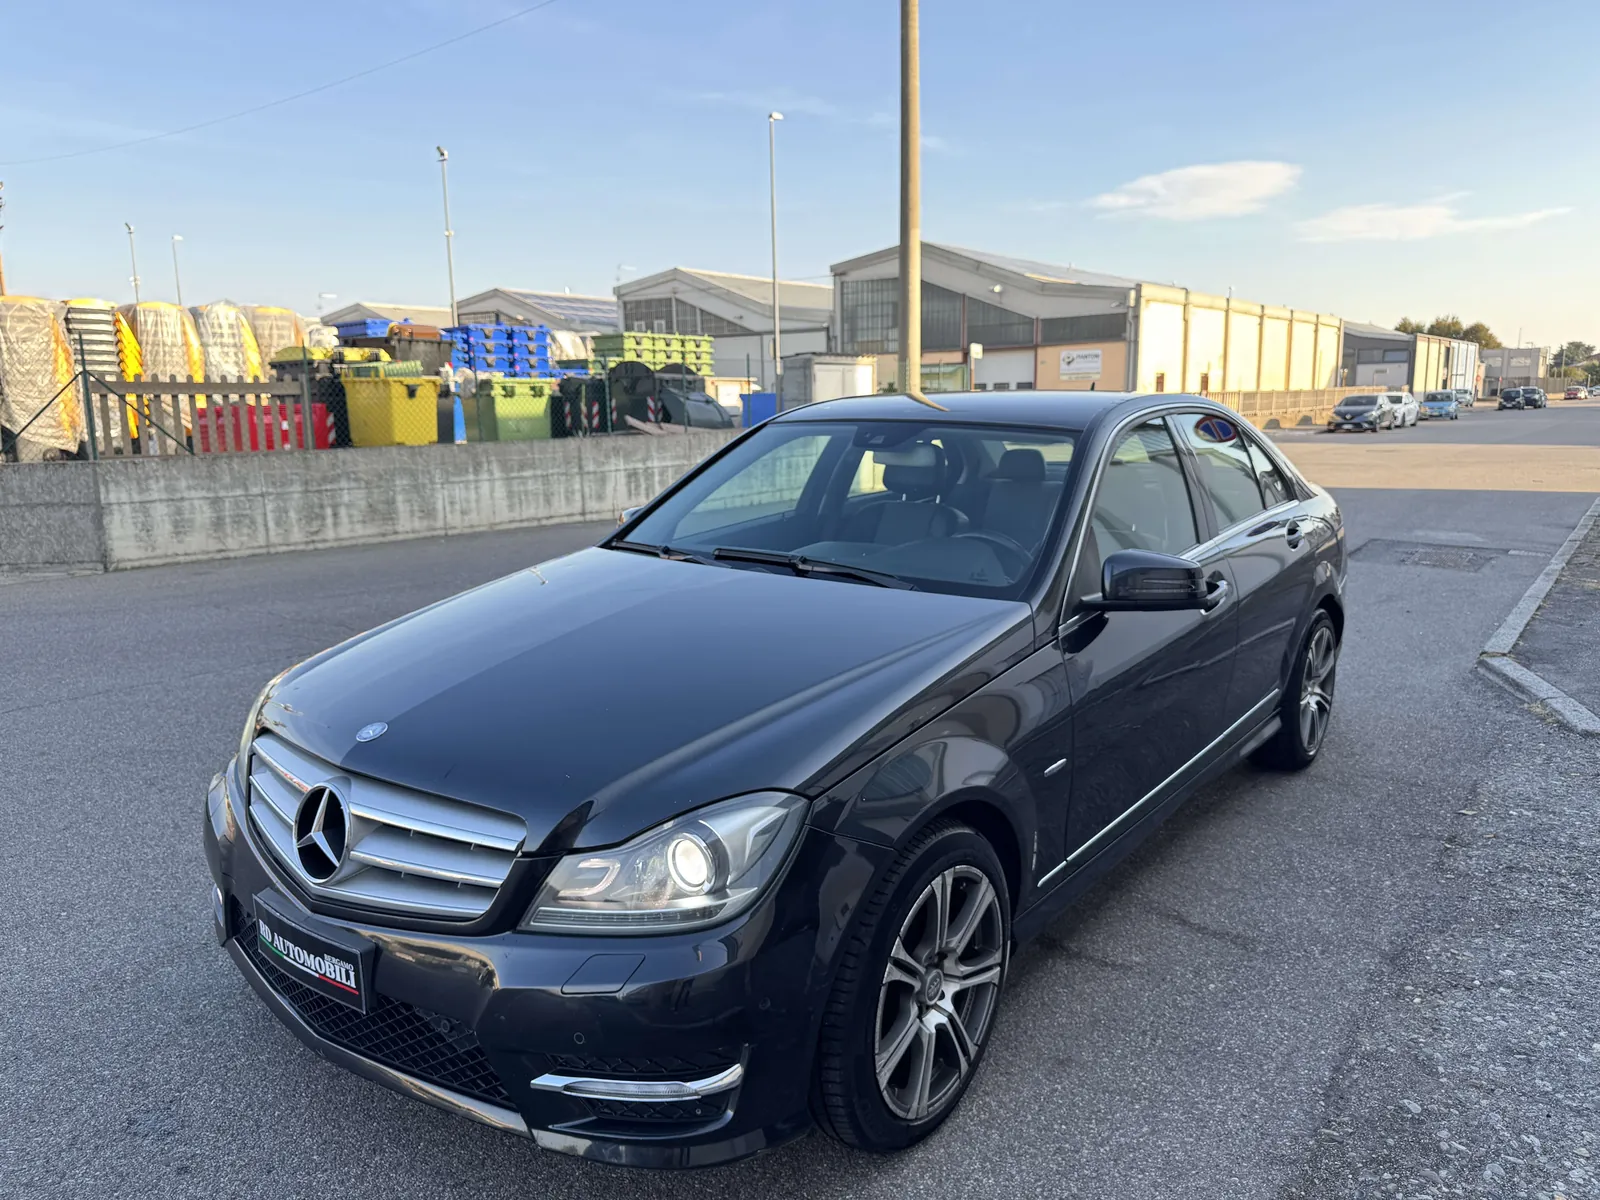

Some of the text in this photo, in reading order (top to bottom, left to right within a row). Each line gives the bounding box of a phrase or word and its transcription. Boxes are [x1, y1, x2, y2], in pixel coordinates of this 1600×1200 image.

[259, 919, 356, 988] RD AUTOMOBILI
[324, 954, 354, 971] BERGAMO
